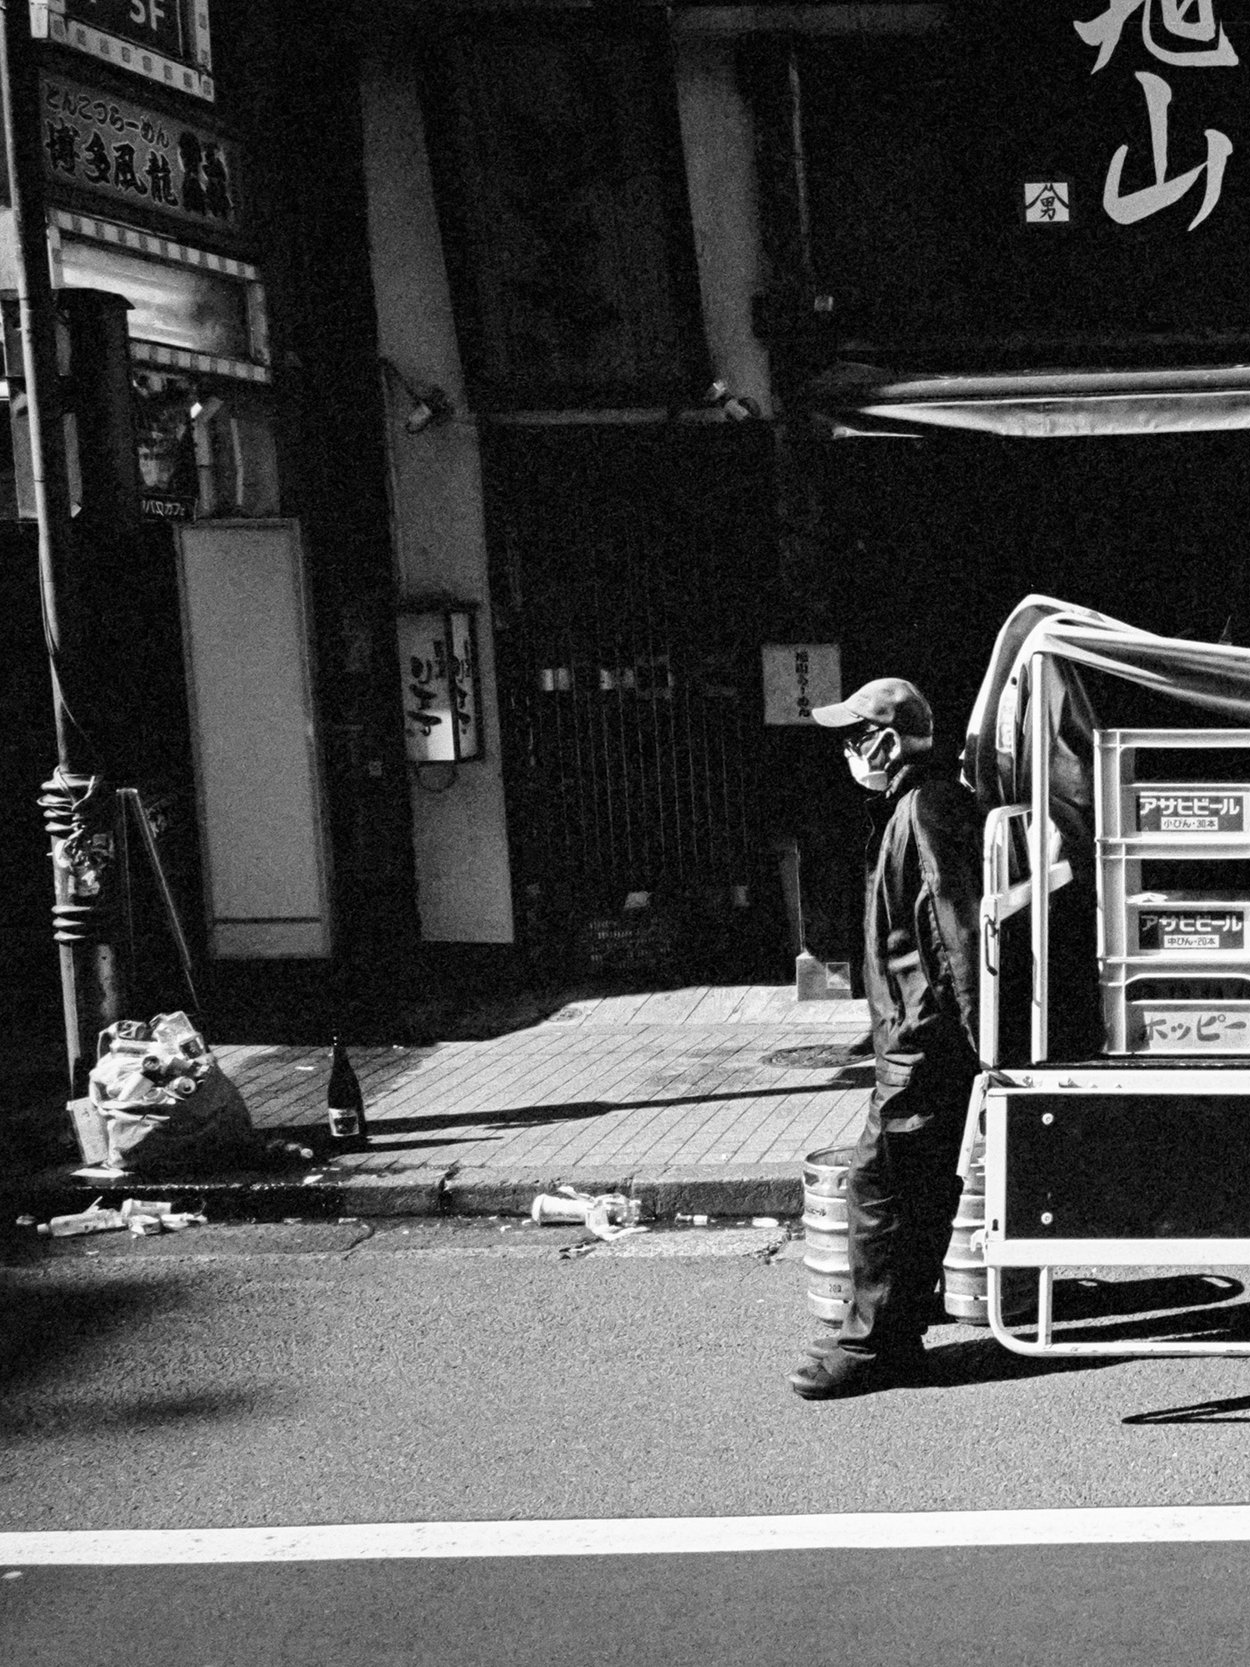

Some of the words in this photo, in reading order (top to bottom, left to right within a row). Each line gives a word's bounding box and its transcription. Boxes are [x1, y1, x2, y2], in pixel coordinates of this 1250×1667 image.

[1140, 798, 1240, 815] アサヒビール
[1141, 915, 1242, 932] アサヒビール
[1144, 1014, 1247, 1042] ホッピー
